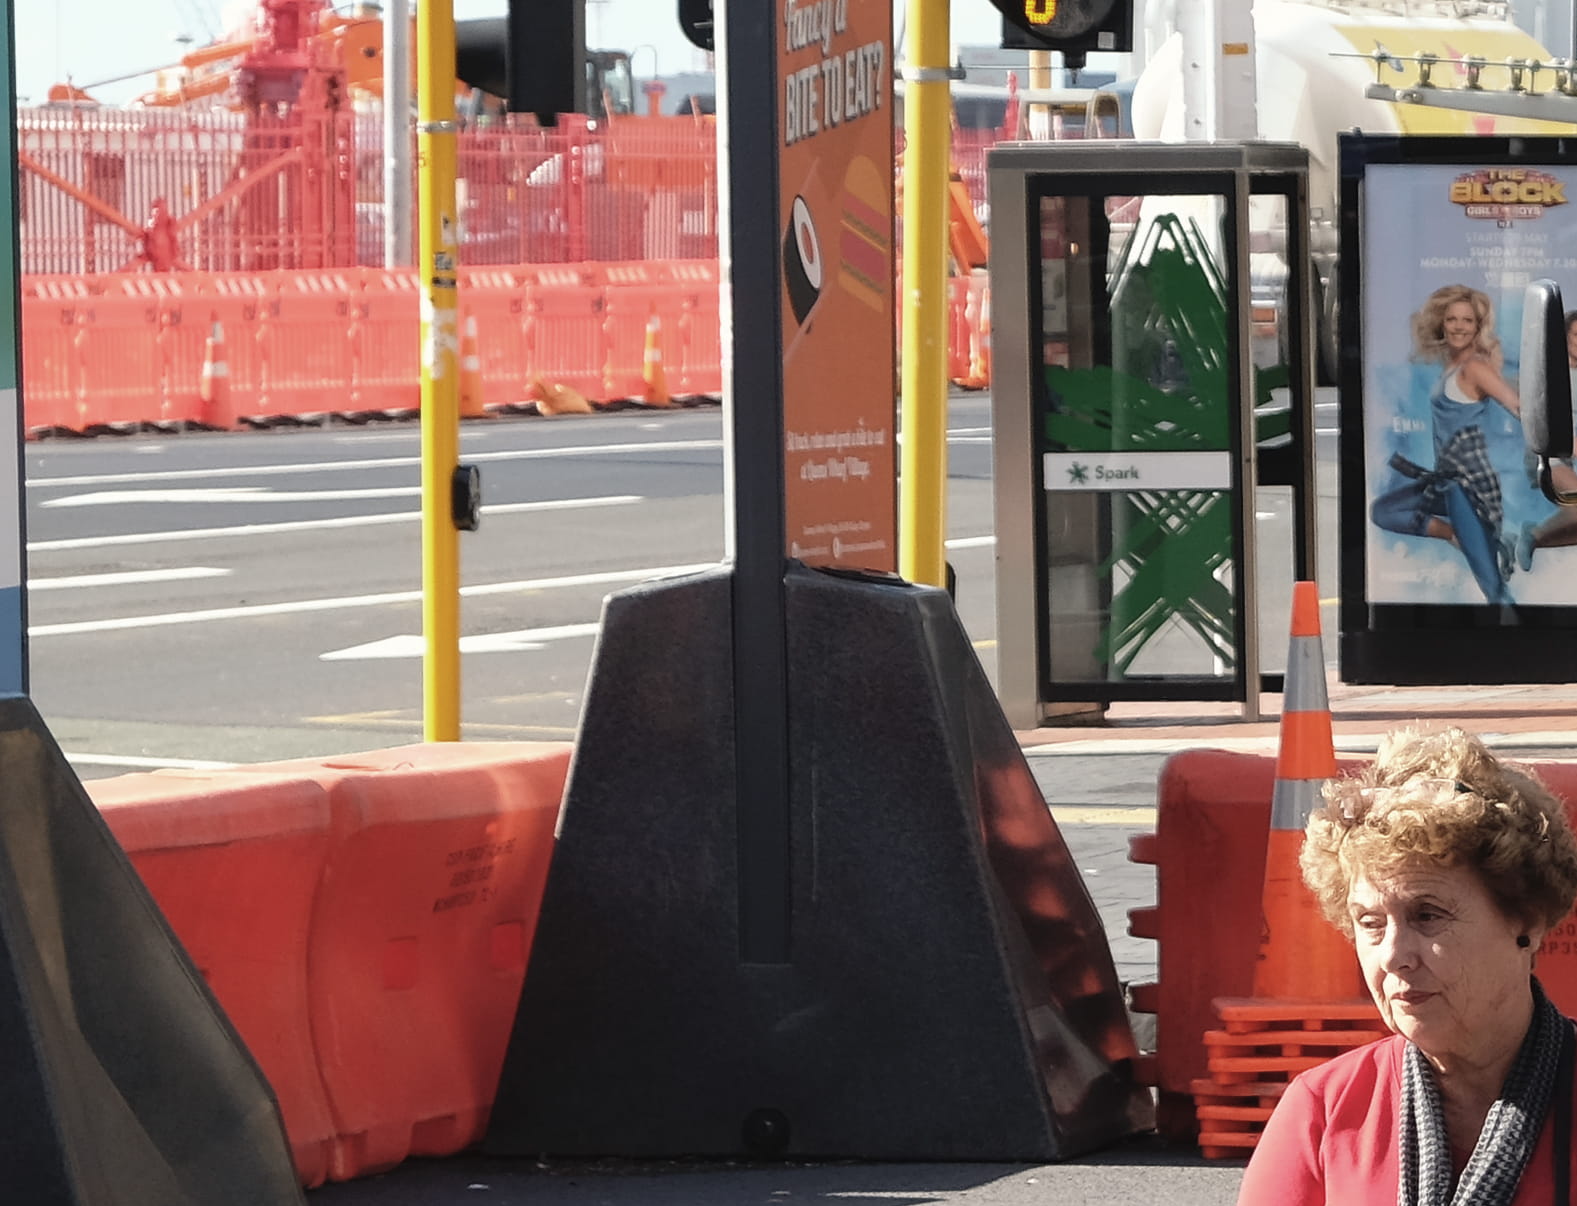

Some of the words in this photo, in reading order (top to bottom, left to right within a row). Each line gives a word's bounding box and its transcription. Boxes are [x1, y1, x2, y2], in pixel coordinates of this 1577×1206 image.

[785, 63, 820, 144] BITE
[822, 56, 842, 129] TO
[844, 40, 884, 119] EAT?
[1488, 168, 1527, 181] THE
[1451, 181, 1569, 203] BLOCK
[1470, 247, 1518, 258] SUNDAY
[1095, 465, 1139, 482] Spark
